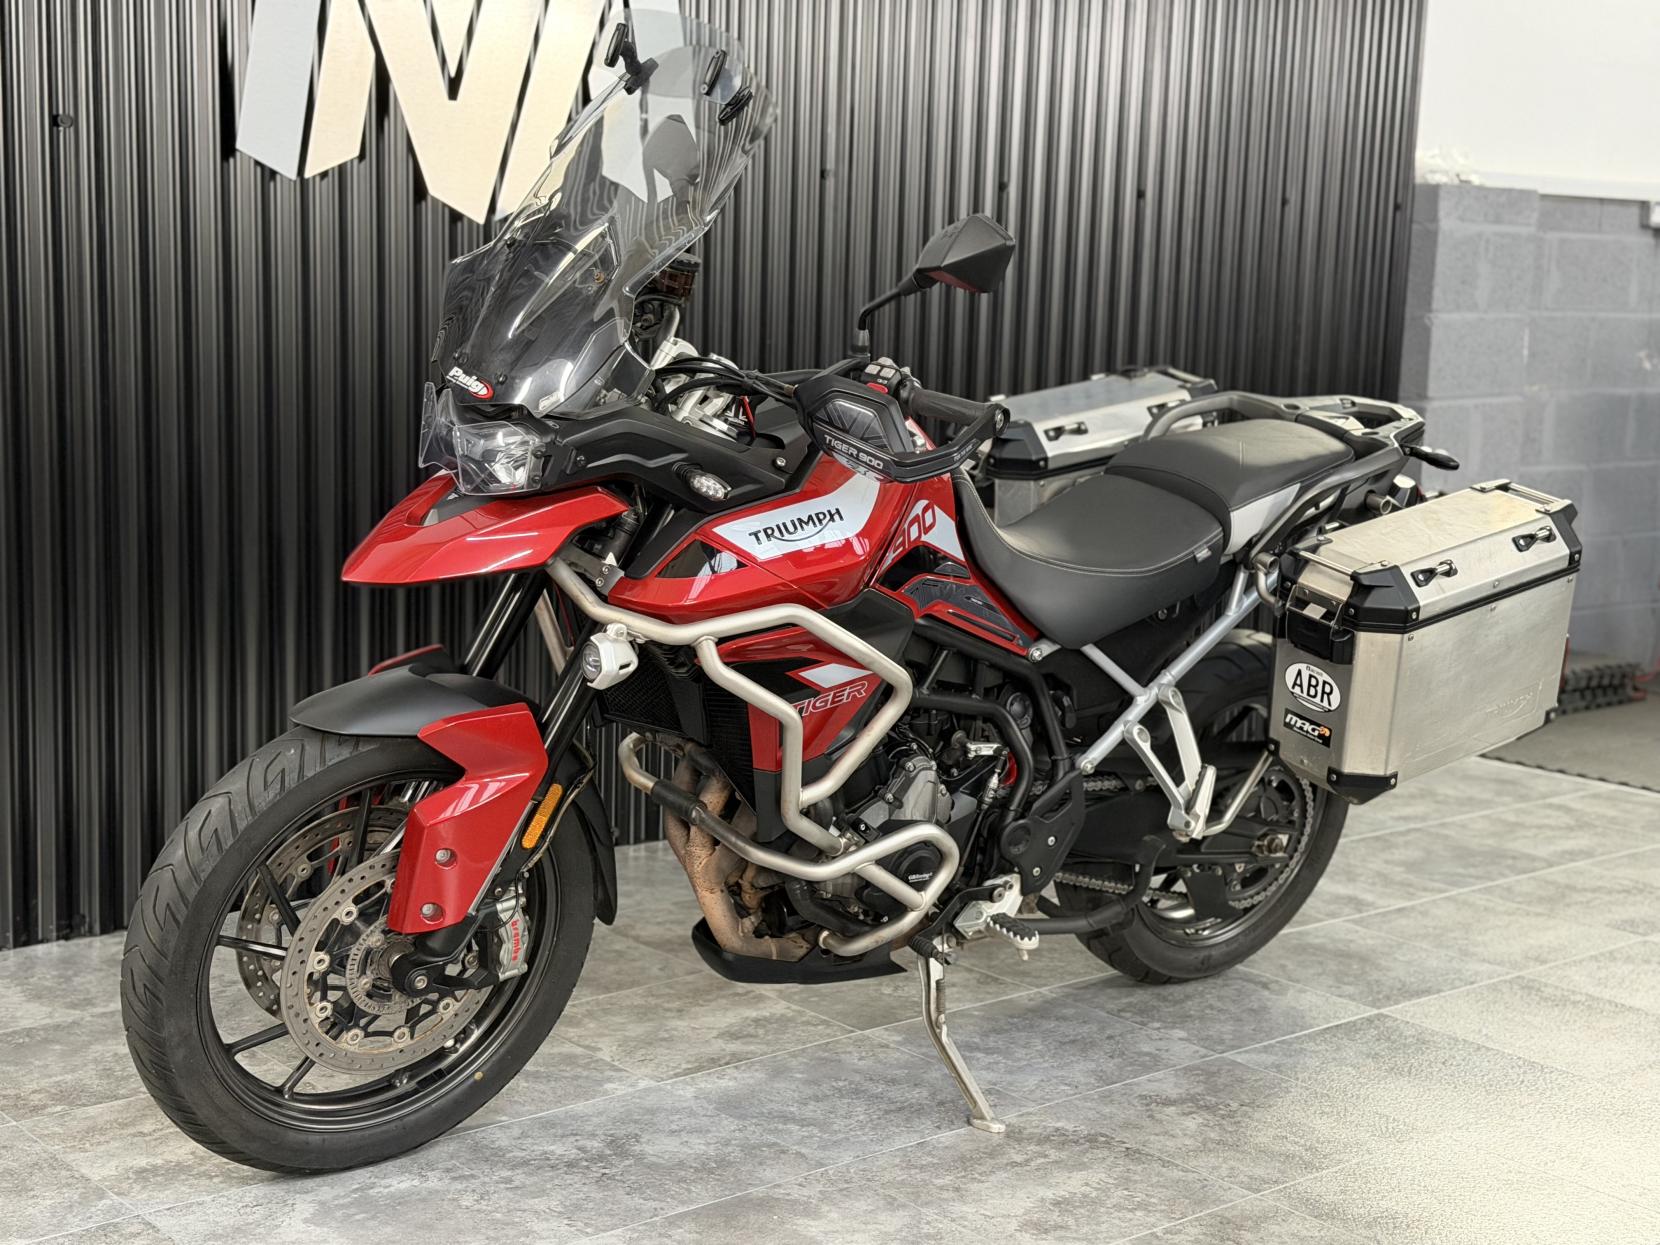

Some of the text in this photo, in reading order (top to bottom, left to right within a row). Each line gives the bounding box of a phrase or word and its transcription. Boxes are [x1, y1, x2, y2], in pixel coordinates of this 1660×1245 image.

[824, 434, 883, 470] TIGER 900
[748, 508, 844, 545] TRIUMPH
[1291, 668, 1333, 707] ABR
